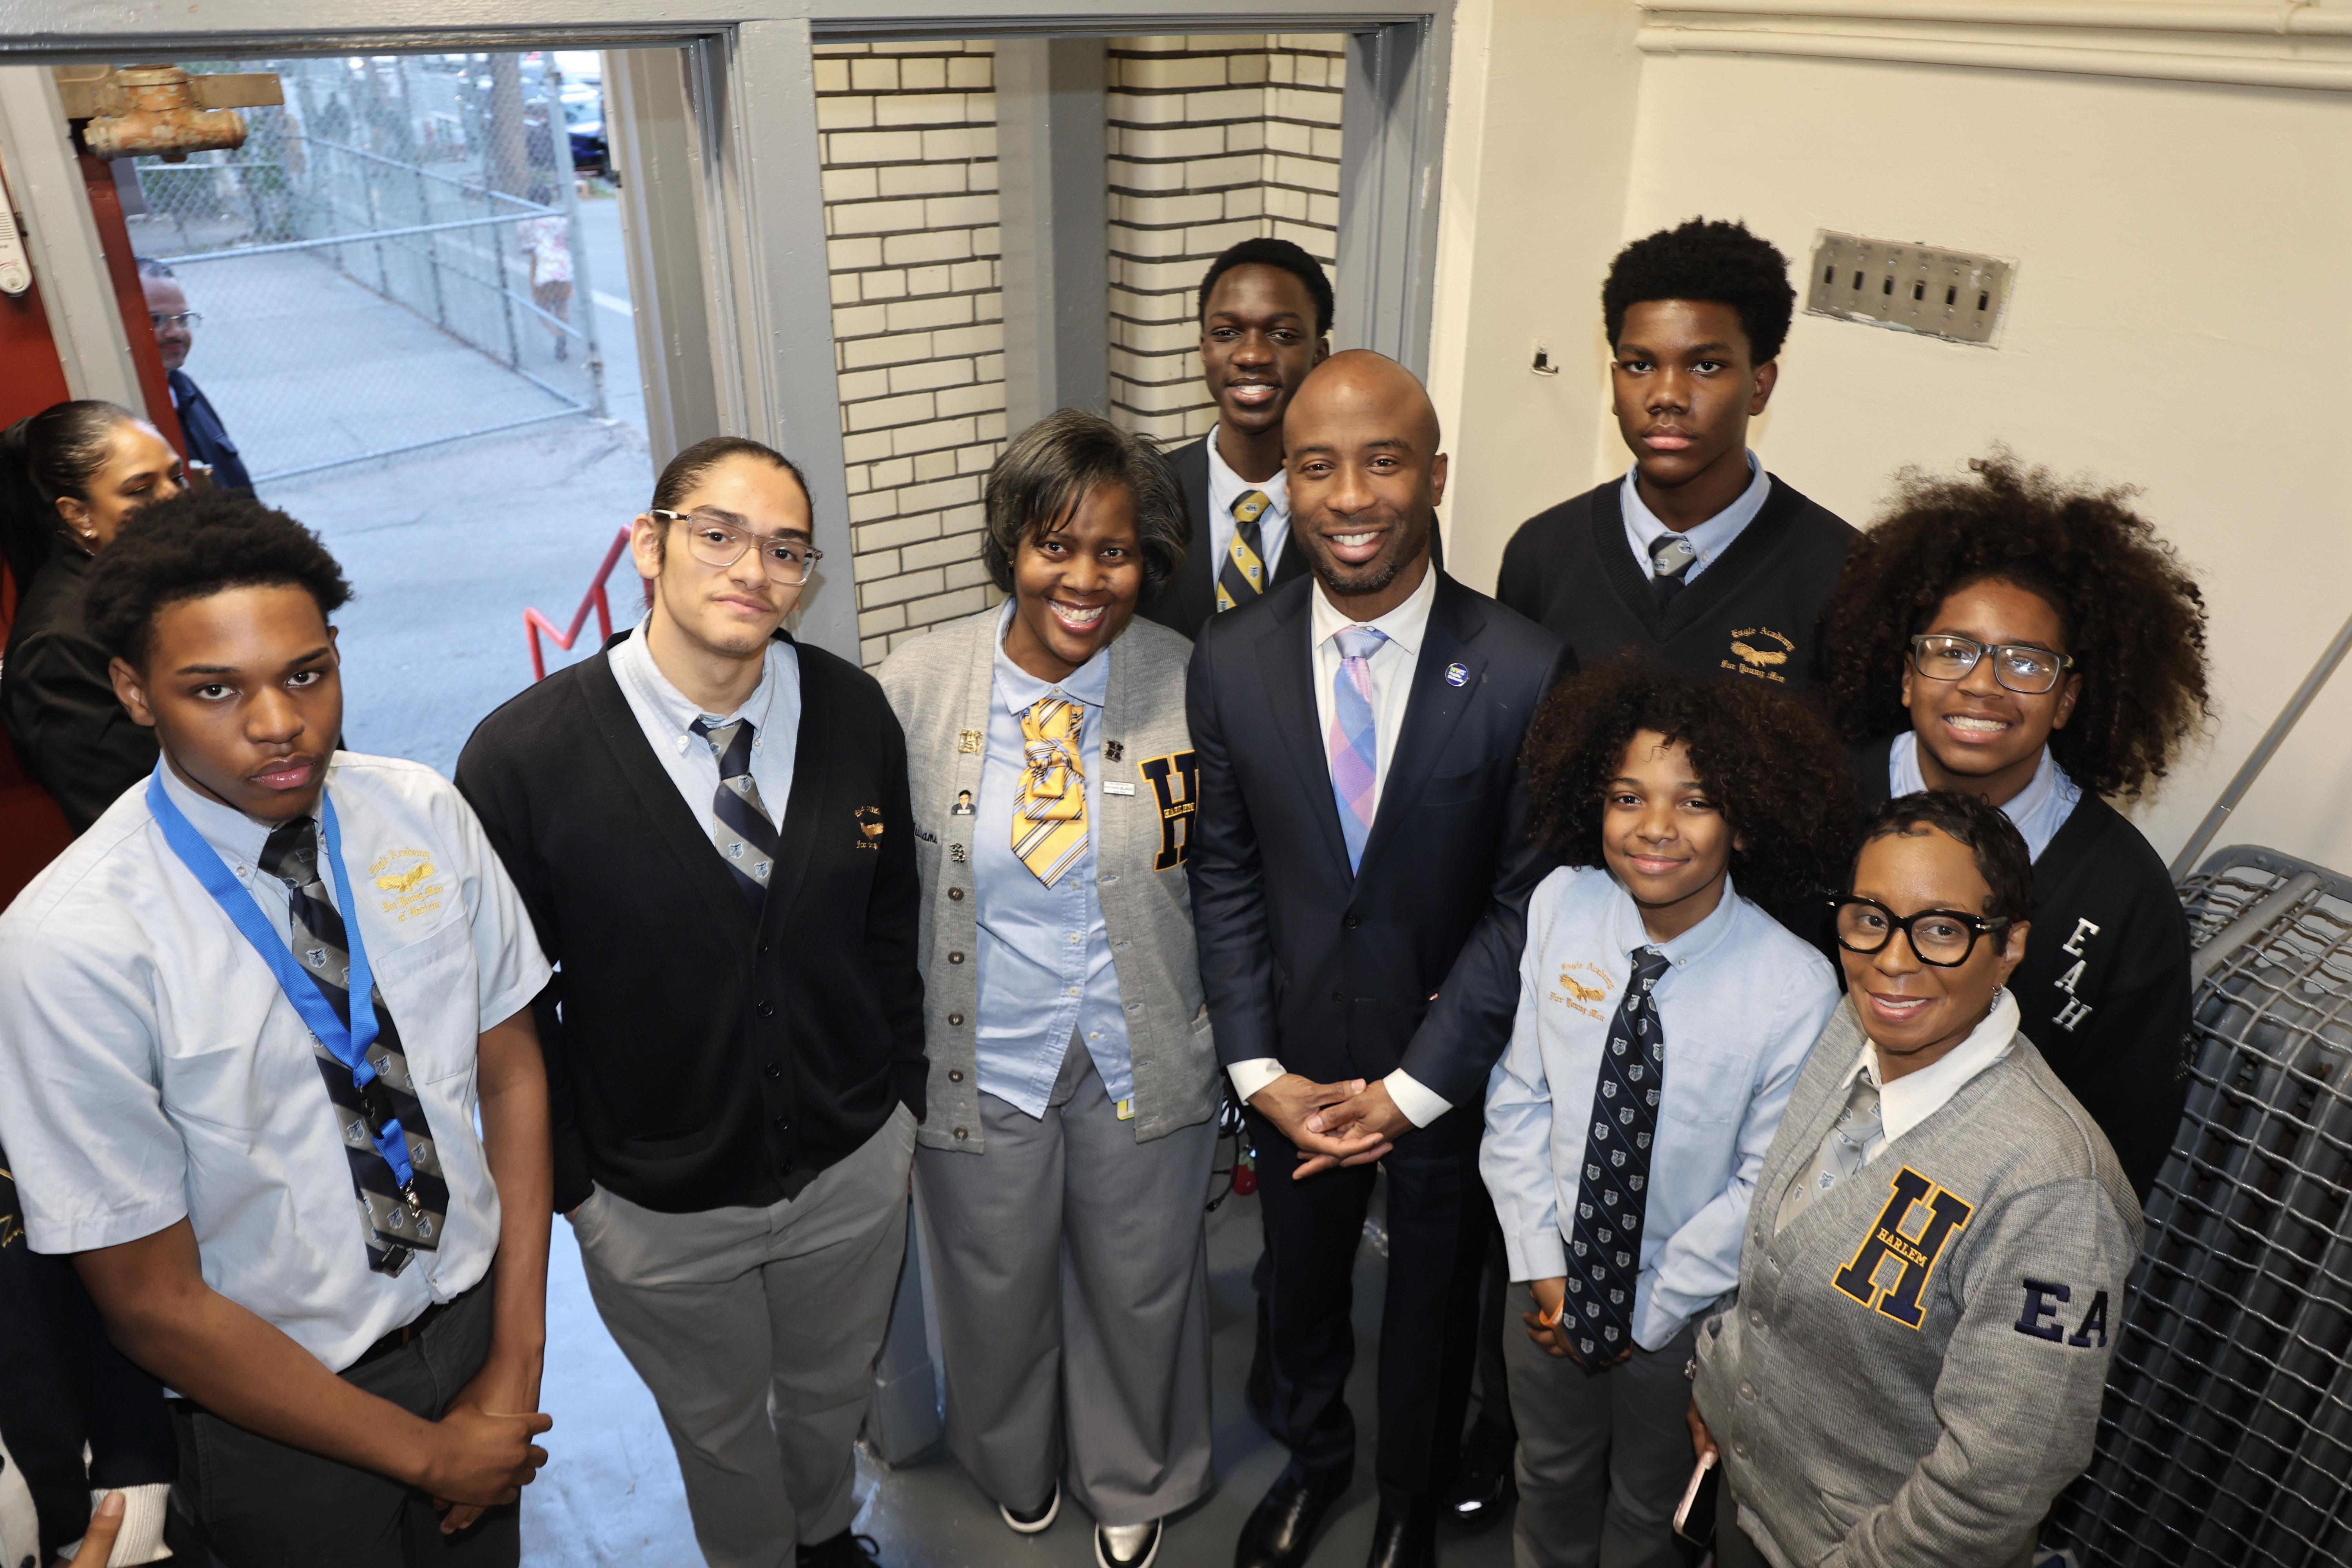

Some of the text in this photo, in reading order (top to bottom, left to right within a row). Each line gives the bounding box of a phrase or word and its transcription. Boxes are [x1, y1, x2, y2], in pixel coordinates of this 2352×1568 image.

[1731, 627, 1795, 652] Eagle Academy
[1720, 660, 1785, 683] For Young Men
[1163, 802, 1195, 818] HARLEM
[368, 848, 429, 875] Eagle Academy
[381, 885, 443, 912] For Young Men
[409, 902, 440, 917] Harlem
[1562, 962, 1613, 989] Eagle Academy
[1549, 992, 1604, 1021] For Young Men
[1877, 1227, 1928, 1268] HARLEM
[2014, 1279, 2108, 1348] EA
